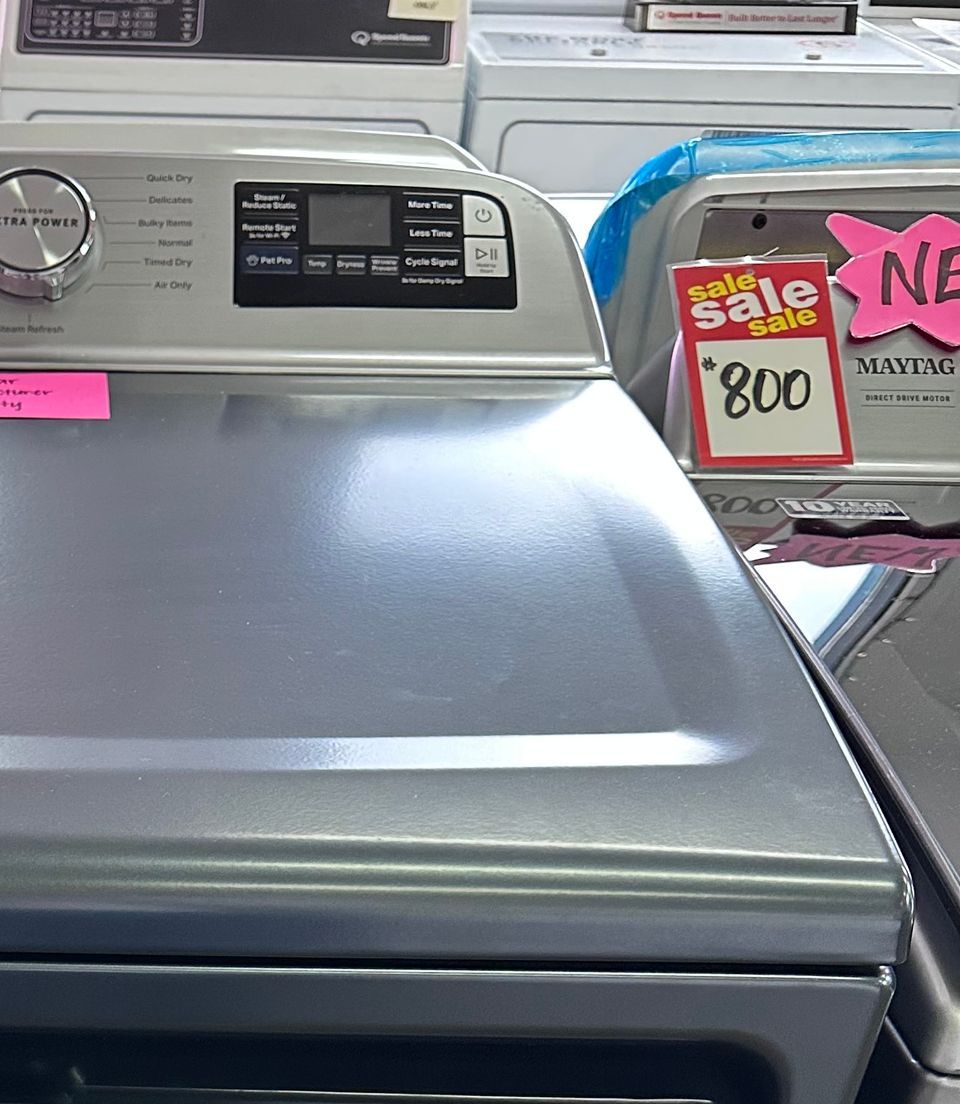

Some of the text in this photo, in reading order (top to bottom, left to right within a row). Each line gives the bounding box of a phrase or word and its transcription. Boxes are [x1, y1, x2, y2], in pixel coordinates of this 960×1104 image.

[146, 173, 193, 184] Quick Dry
[149, 195, 193, 204] Delicates
[408, 200, 453, 210] More Time
[32, 217, 79, 228] POWER
[138, 219, 165, 229] Bulky
[242, 223, 297, 233] Remote Start
[409, 228, 453, 238] Less Time
[158, 239, 193, 248] Normal
[144, 258, 193, 268] Timed Dry
[260, 255, 293, 266] Pet Pro
[307, 259, 327, 269] Temp
[404, 257, 459, 269] Cycle Signal
[169, 280, 193, 291] Only
[687, 273, 758, 304] sale
[689, 276, 820, 331] sale
[747, 307, 818, 337] sale
[27, 324, 65, 334] Refresh
[854, 357, 956, 375] MAYTAG
[865, 394, 894, 402] DIRECT
[896, 394, 920, 402] DRIVE
[784, 500, 836, 513] 10
